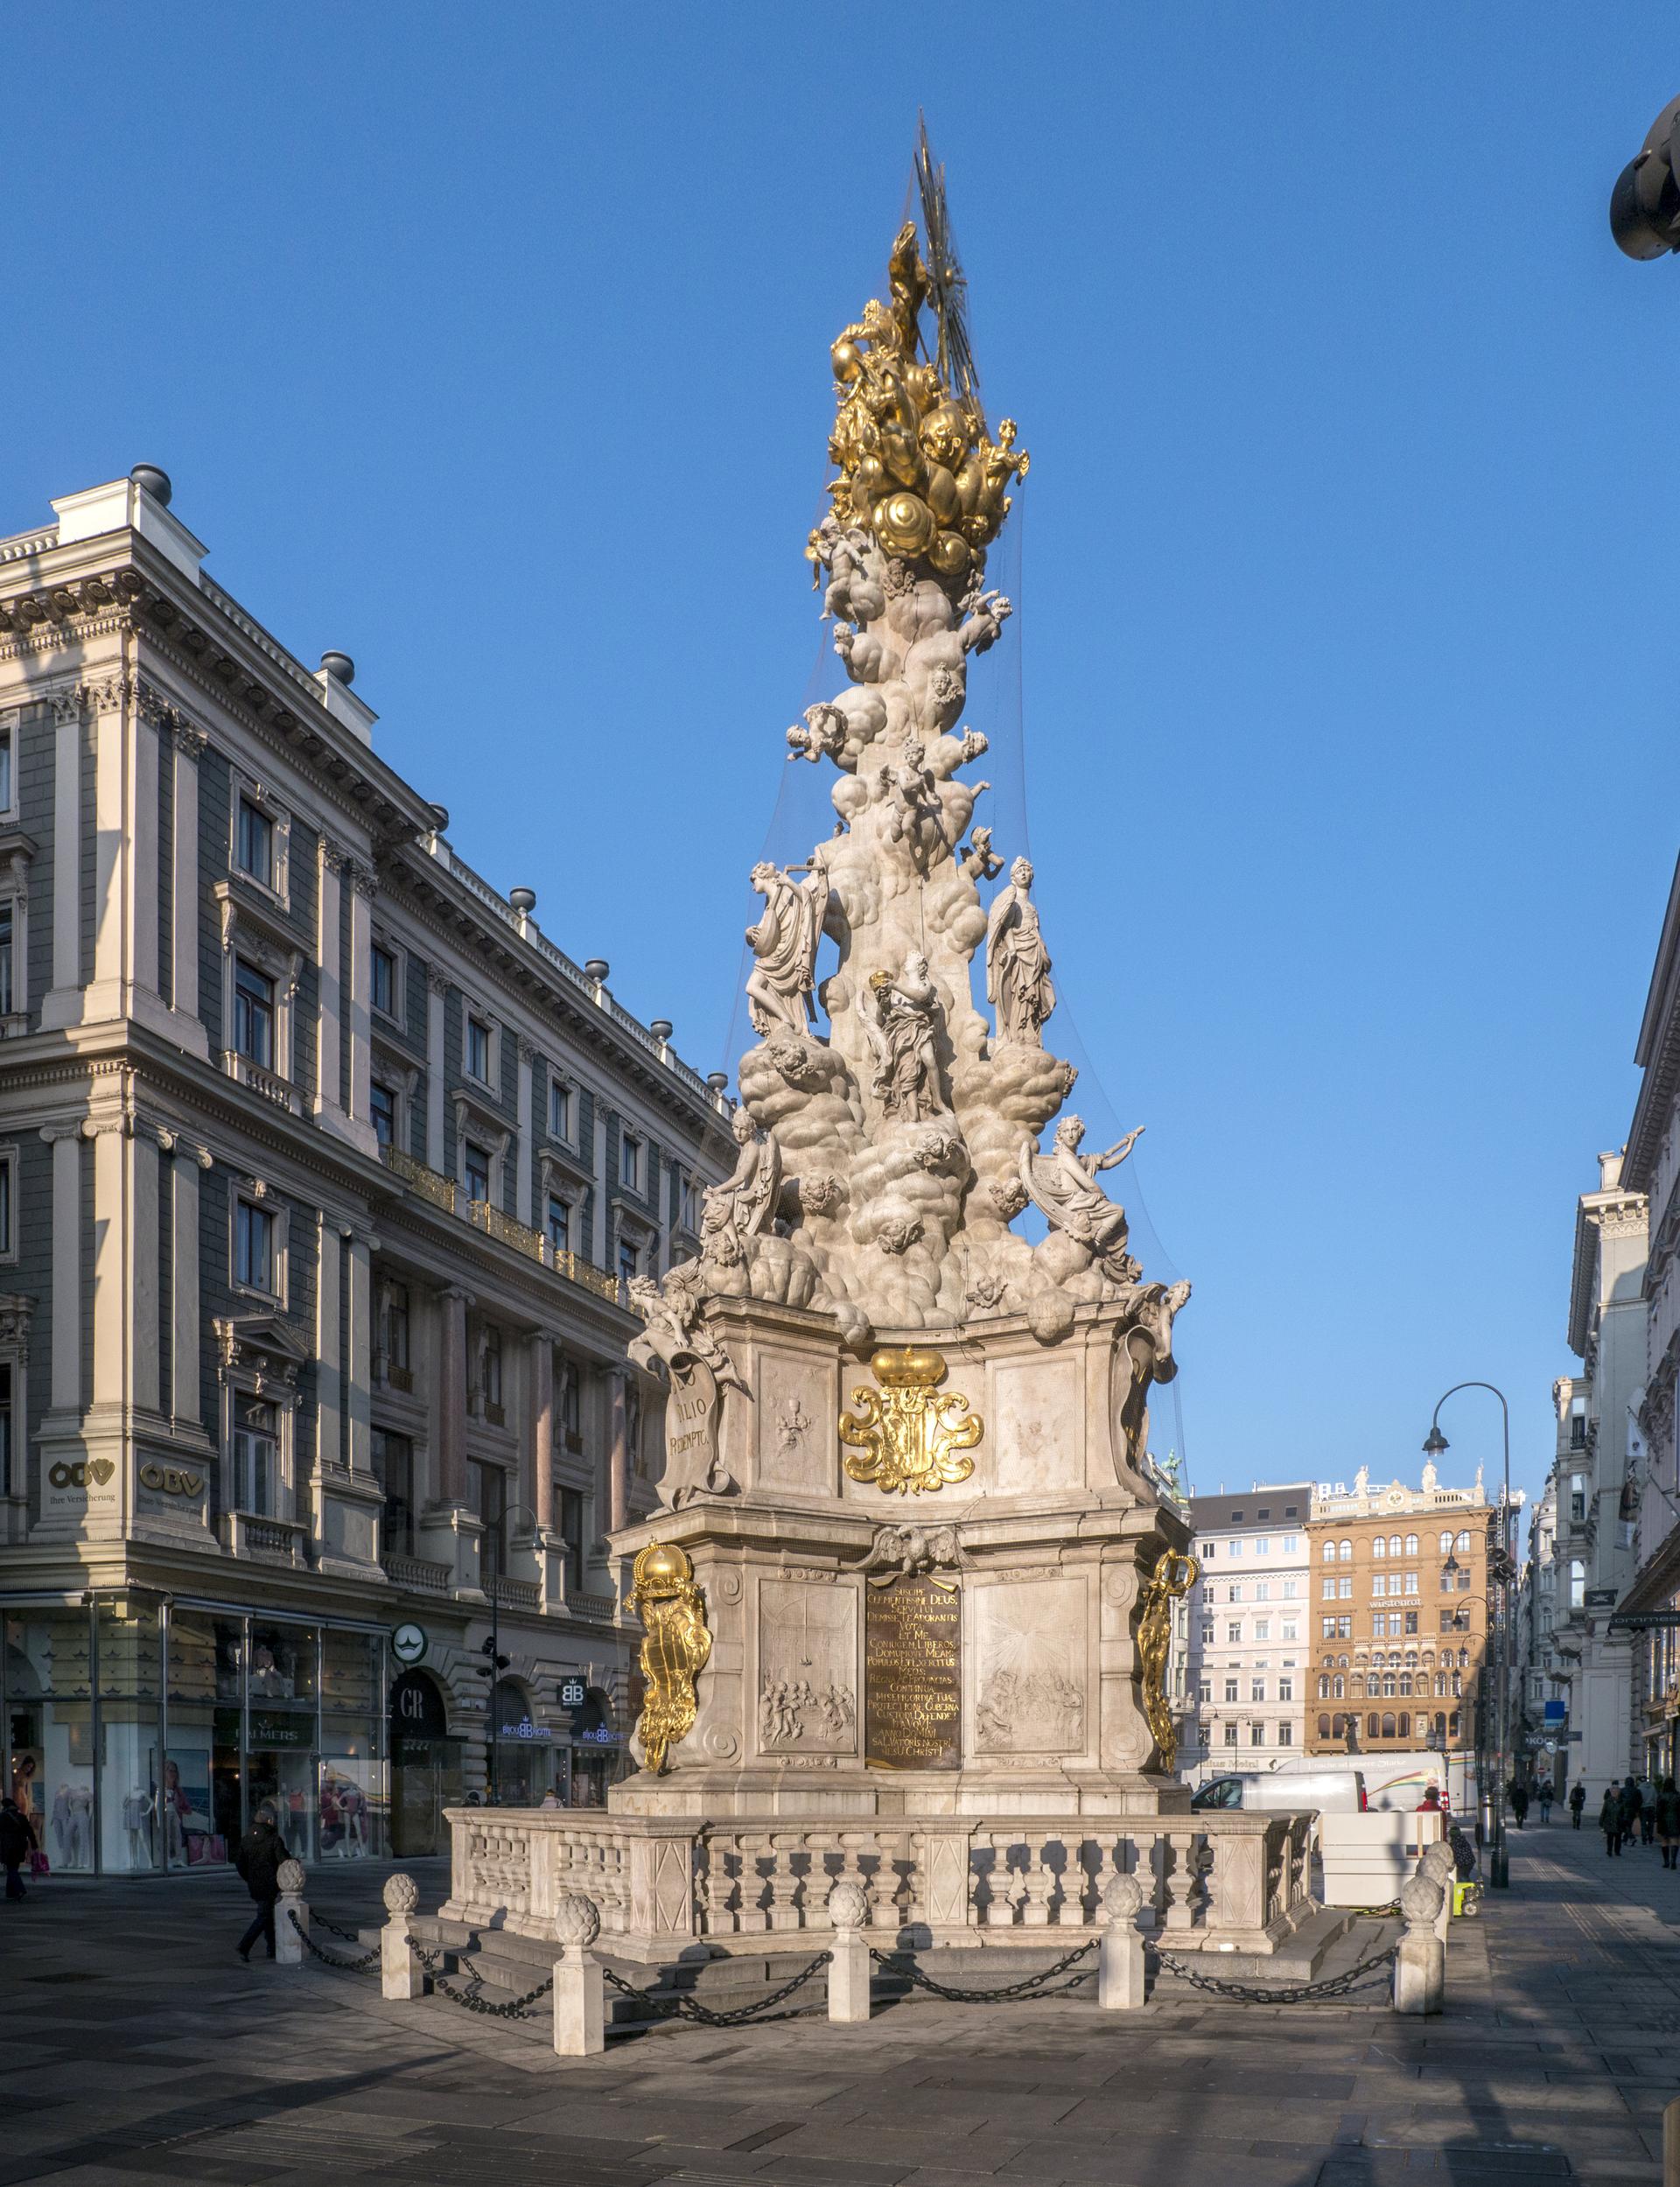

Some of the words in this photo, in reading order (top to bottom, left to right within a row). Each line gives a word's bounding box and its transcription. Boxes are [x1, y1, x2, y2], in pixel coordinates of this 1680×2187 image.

[669, 1429, 710, 1456] REDEMPTO
[50, 1496, 66, 1505] Ihre
[66, 1494, 116, 1504] Versicherung
[235, 1728, 298, 1741] LMERS
[1201, 1759, 1225, 1768] ulius
